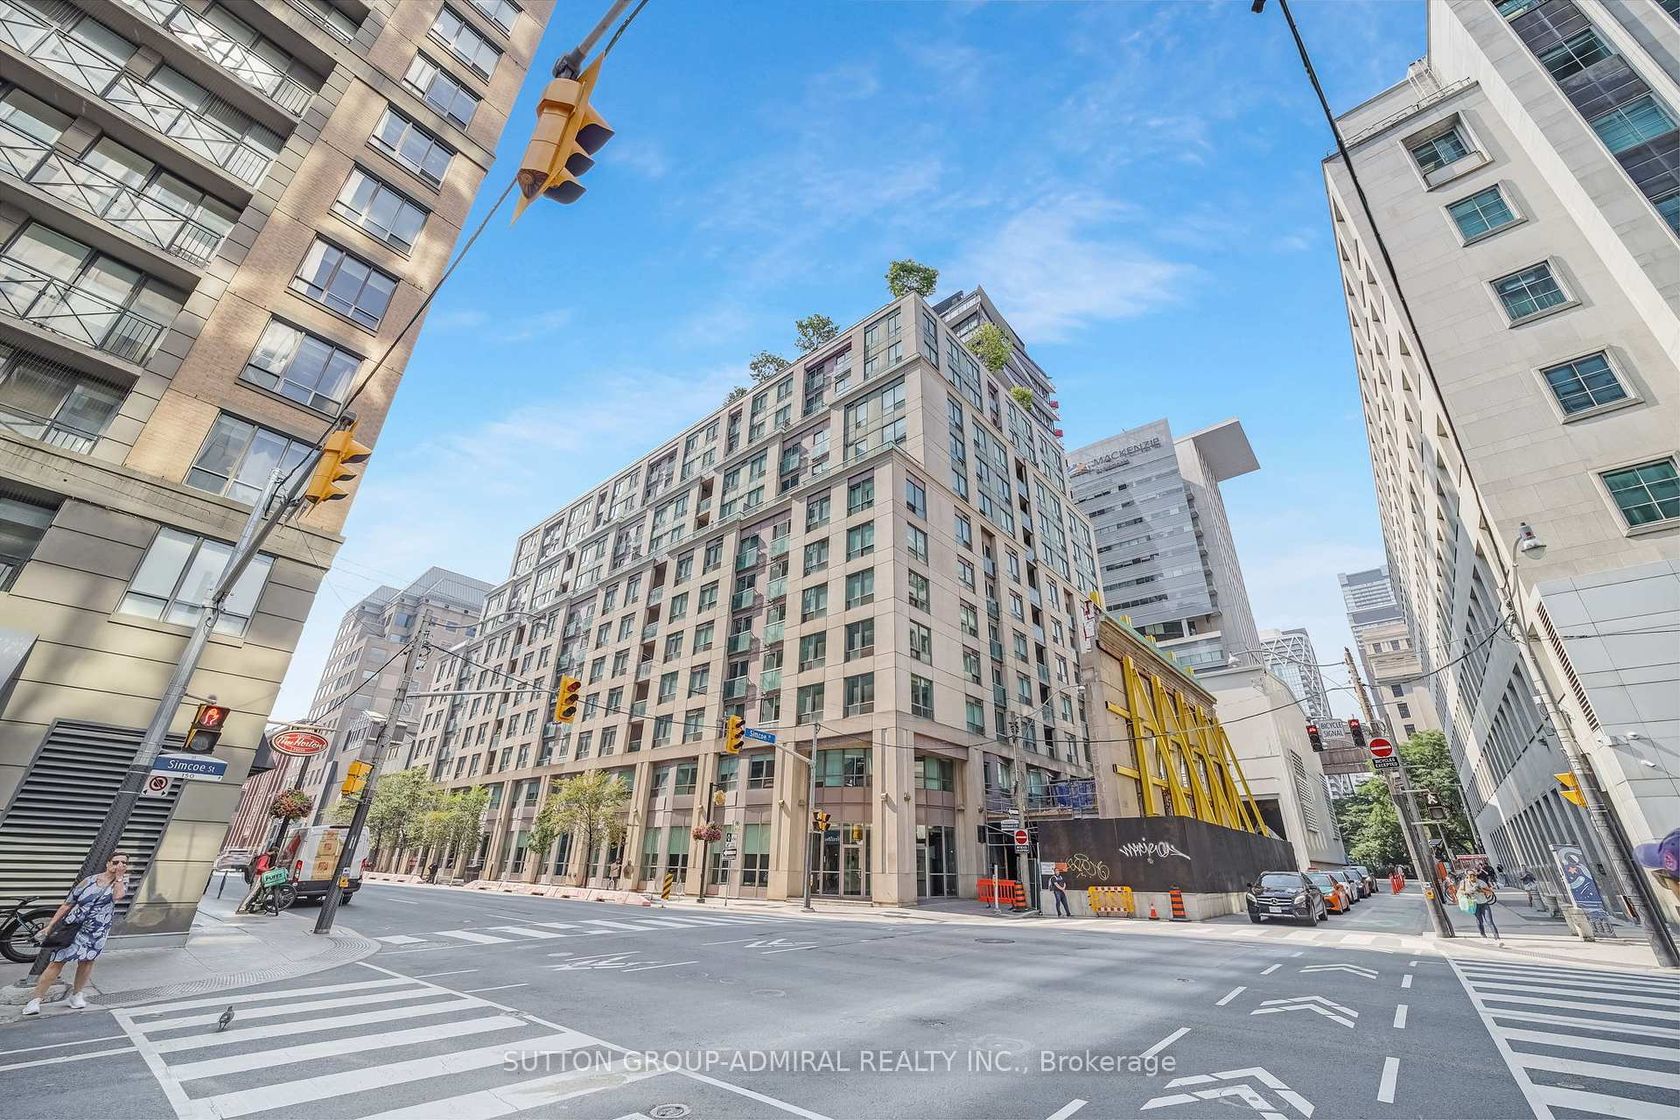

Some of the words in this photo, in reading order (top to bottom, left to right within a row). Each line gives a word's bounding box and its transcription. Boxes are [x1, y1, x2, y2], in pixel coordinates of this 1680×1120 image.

[1320, 722, 1344, 730] BICYCLE
[1323, 730, 1344, 738] SIGNAL
[167, 759, 206, 772] Simcoe
[207, 765, 216, 773] St
